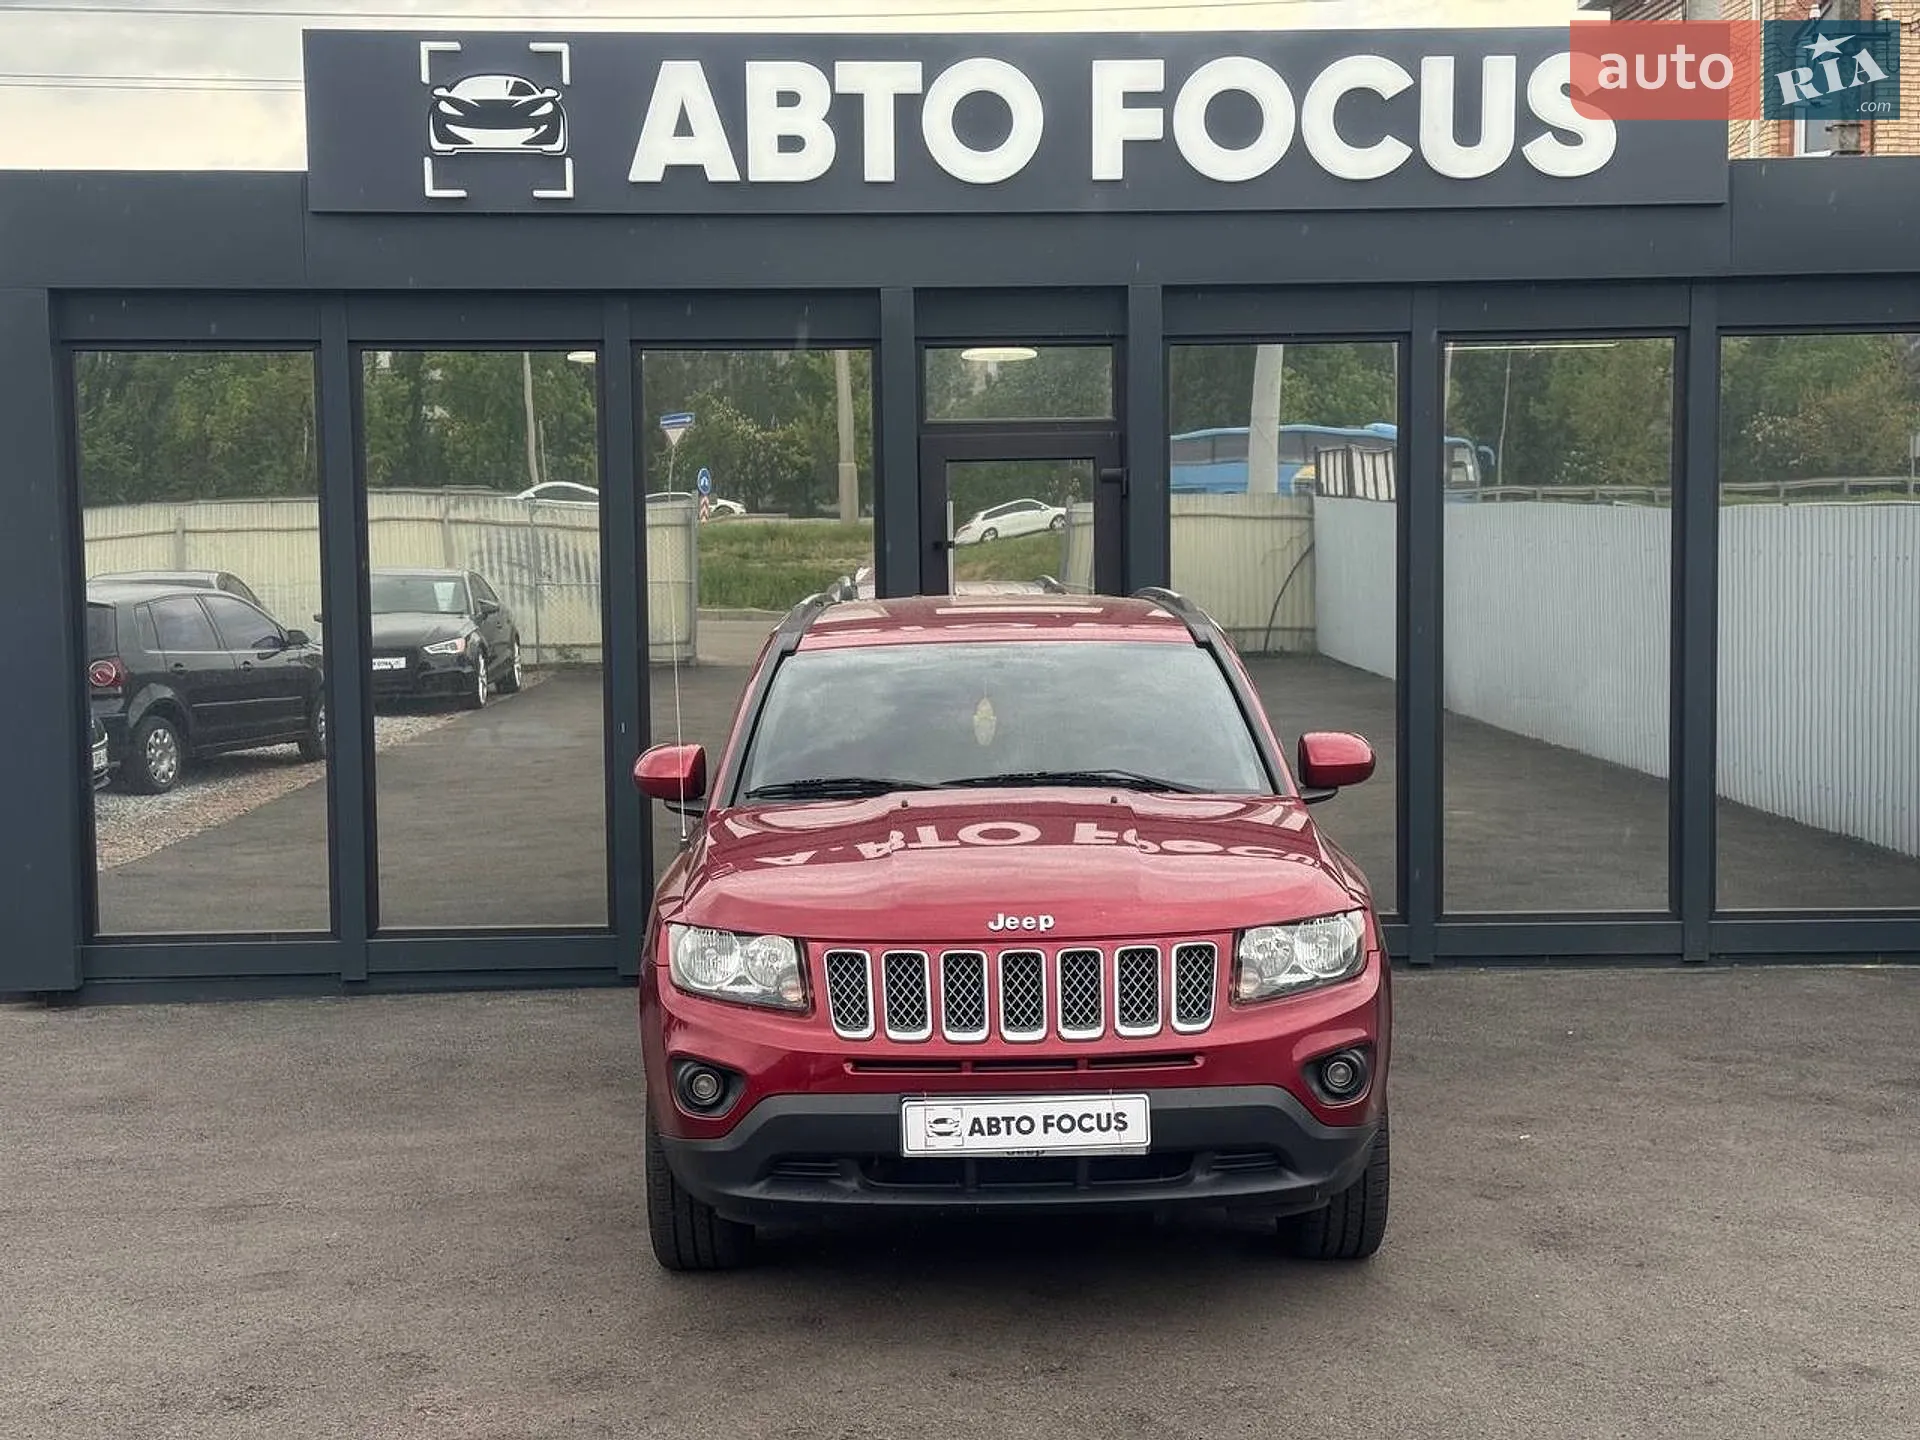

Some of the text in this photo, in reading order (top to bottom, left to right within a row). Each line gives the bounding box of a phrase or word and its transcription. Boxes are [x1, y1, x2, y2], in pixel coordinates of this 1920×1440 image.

[628, 51, 1618, 184] АВТО FOCUS
[987, 912, 1056, 932] Jeep
[968, 1111, 1129, 1137] АВТО FOCUS
